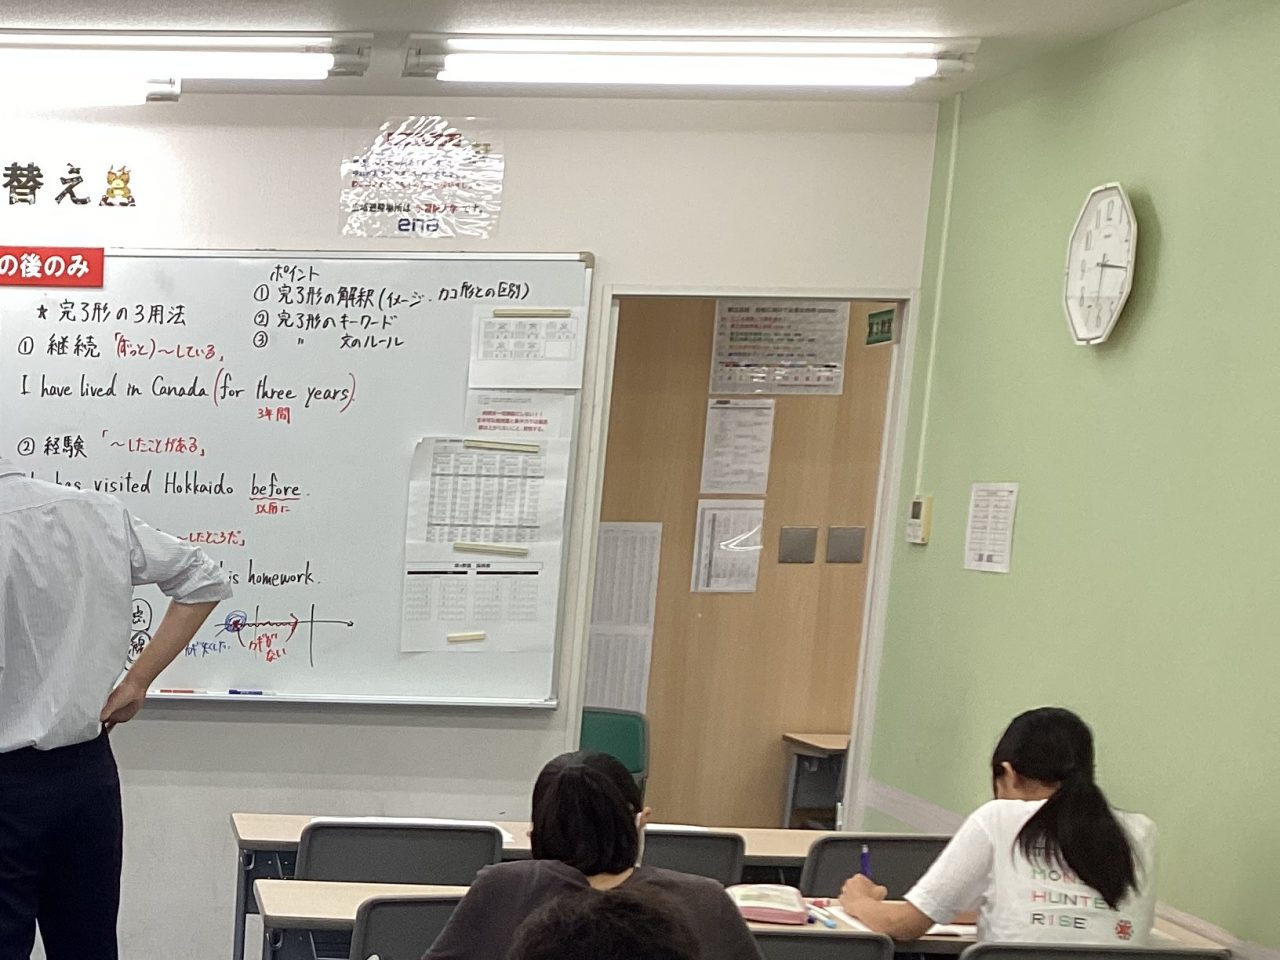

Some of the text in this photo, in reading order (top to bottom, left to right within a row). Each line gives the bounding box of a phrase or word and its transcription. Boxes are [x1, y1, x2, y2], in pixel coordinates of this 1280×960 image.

[270, 264, 320, 282] ポイント
[277, 309, 398, 331] 完了形のキーワード
[47, 333, 101, 358] 継続
[339, 335, 404, 349] 文のルール
[20, 375, 31, 395] I
[41, 375, 72, 396] have
[80, 373, 117, 396] lived
[127, 382, 142, 396] in
[151, 376, 208, 396] Canada
[257, 376, 296, 399] three
[257, 406, 291, 424] 3年間
[44, 435, 87, 458] 経験
[94, 470, 151, 494] visited
[164, 471, 233, 495] Hokkaido
[1031, 913, 1087, 929] RISE
